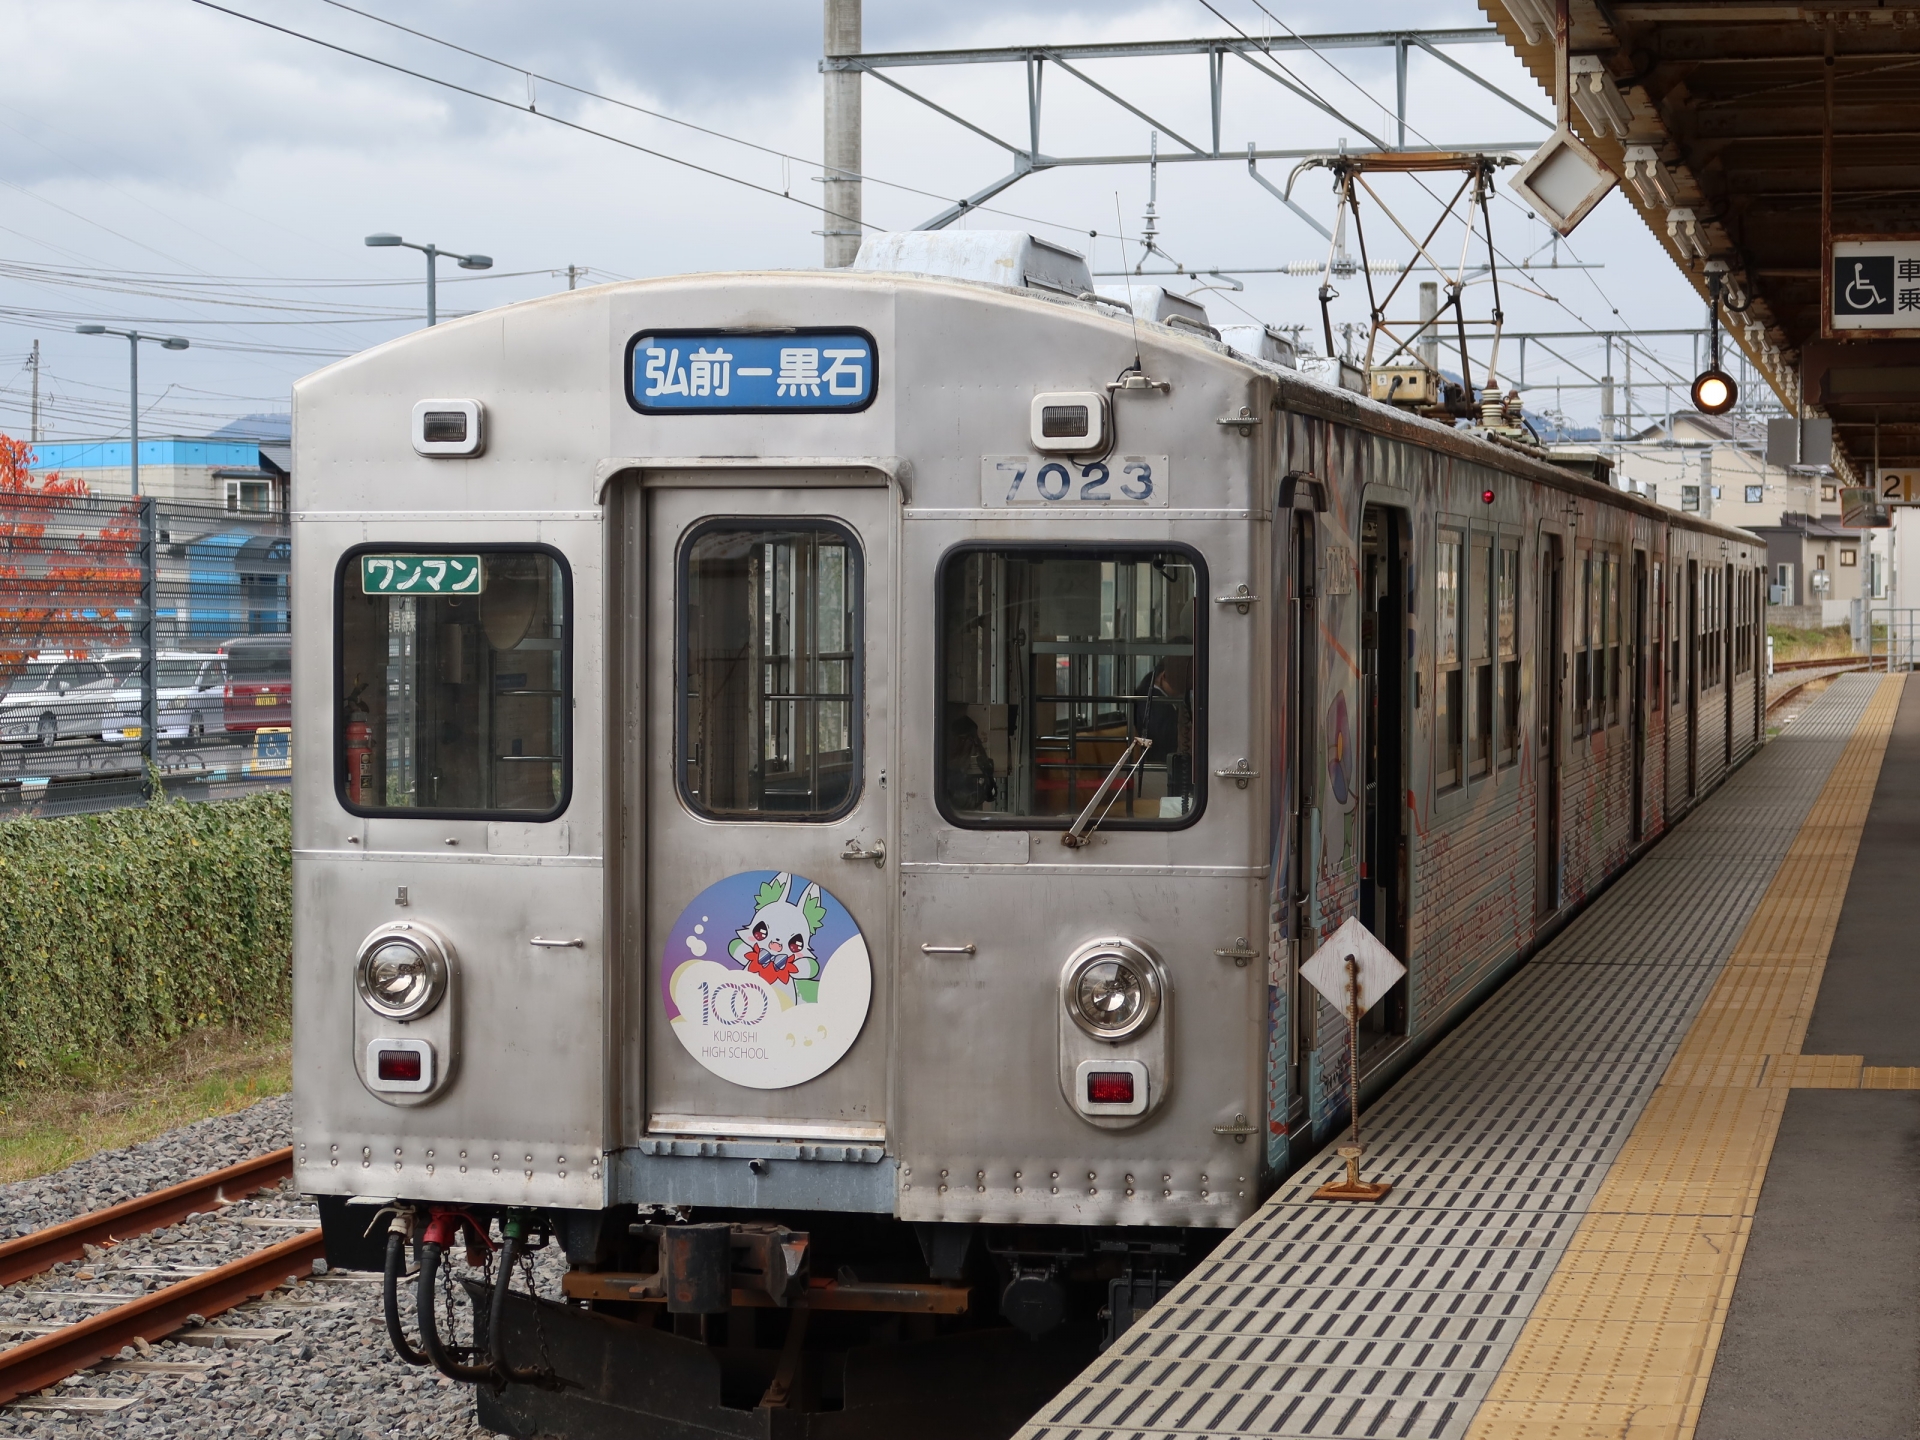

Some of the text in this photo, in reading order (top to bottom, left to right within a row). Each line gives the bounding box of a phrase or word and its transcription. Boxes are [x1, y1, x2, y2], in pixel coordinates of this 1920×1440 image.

[996, 462, 1154, 501] 7023
[1883, 474, 1901, 498] 2
[367, 559, 478, 591] ワンマン
[697, 981, 769, 1026] 100
[713, 1030, 758, 1043] KUROISHI
[701, 1046, 769, 1060] HIGH SCHOOL
